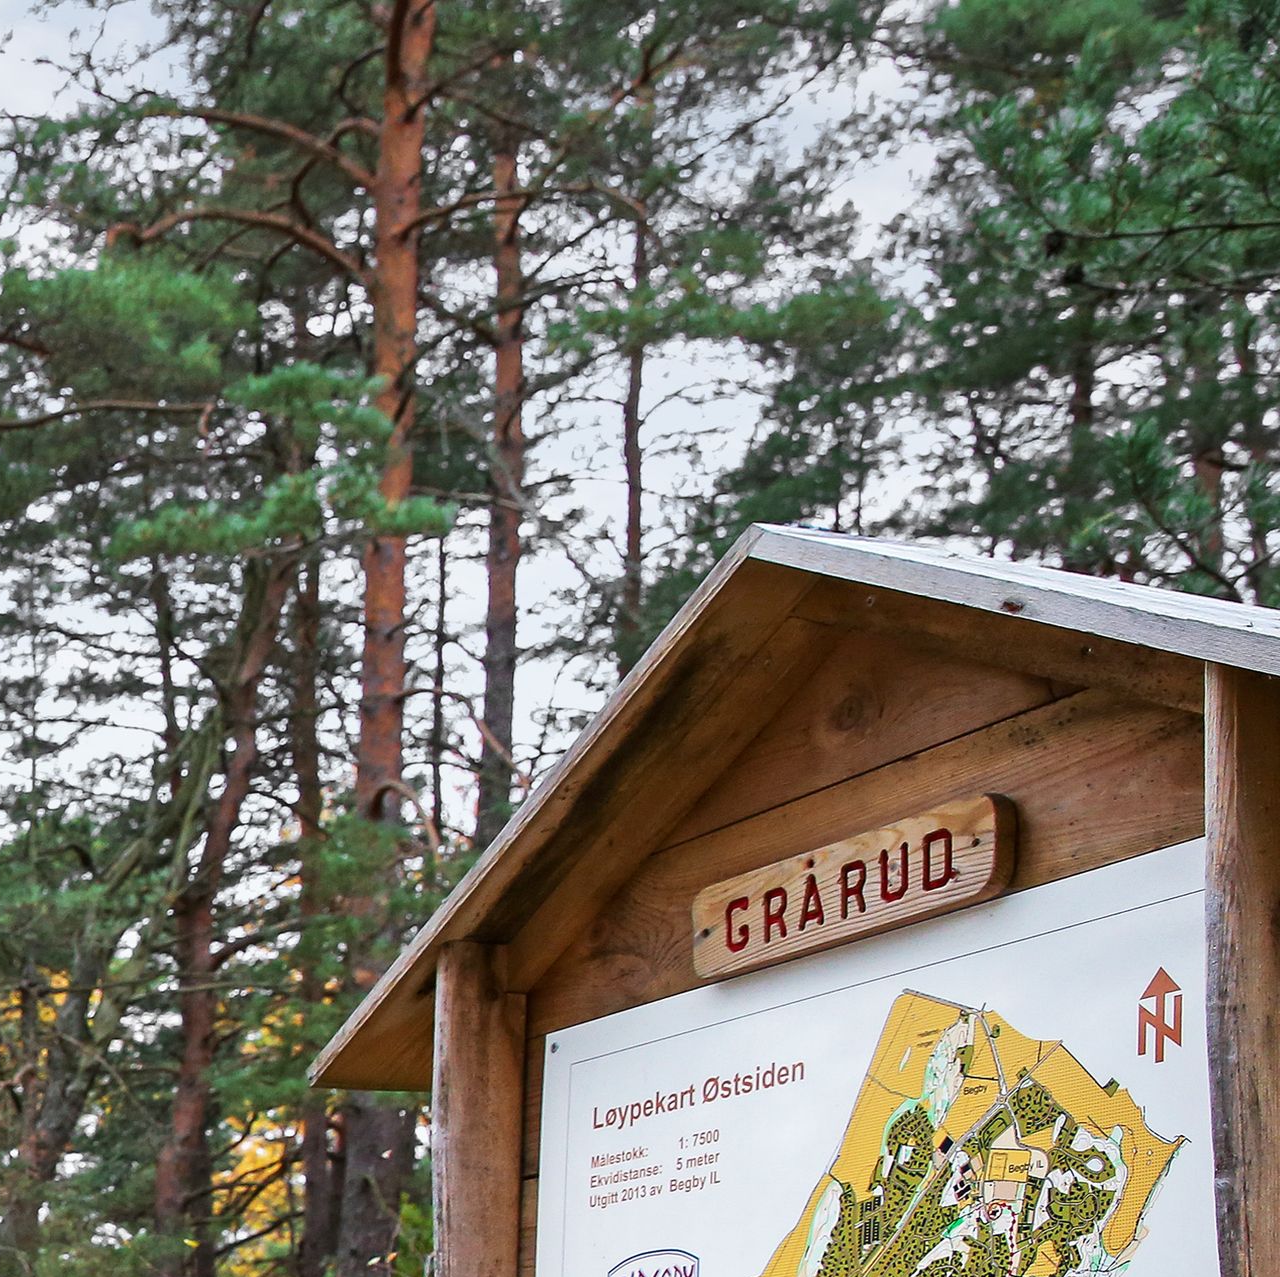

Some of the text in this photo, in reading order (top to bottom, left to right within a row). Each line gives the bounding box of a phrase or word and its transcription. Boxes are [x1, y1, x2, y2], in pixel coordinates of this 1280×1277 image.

[725, 828, 952, 953] GRÅRUD
[592, 1061, 805, 1129] Løypekart Østsiden
[963, 1084, 988, 1096] Begby
[591, 1129, 720, 1168] Målestokk: 1: 7500
[590, 1152, 720, 1188] Ekvidistanse: 5 meter
[589, 1171, 721, 1209] Utgitt 2013 av Begby IL
